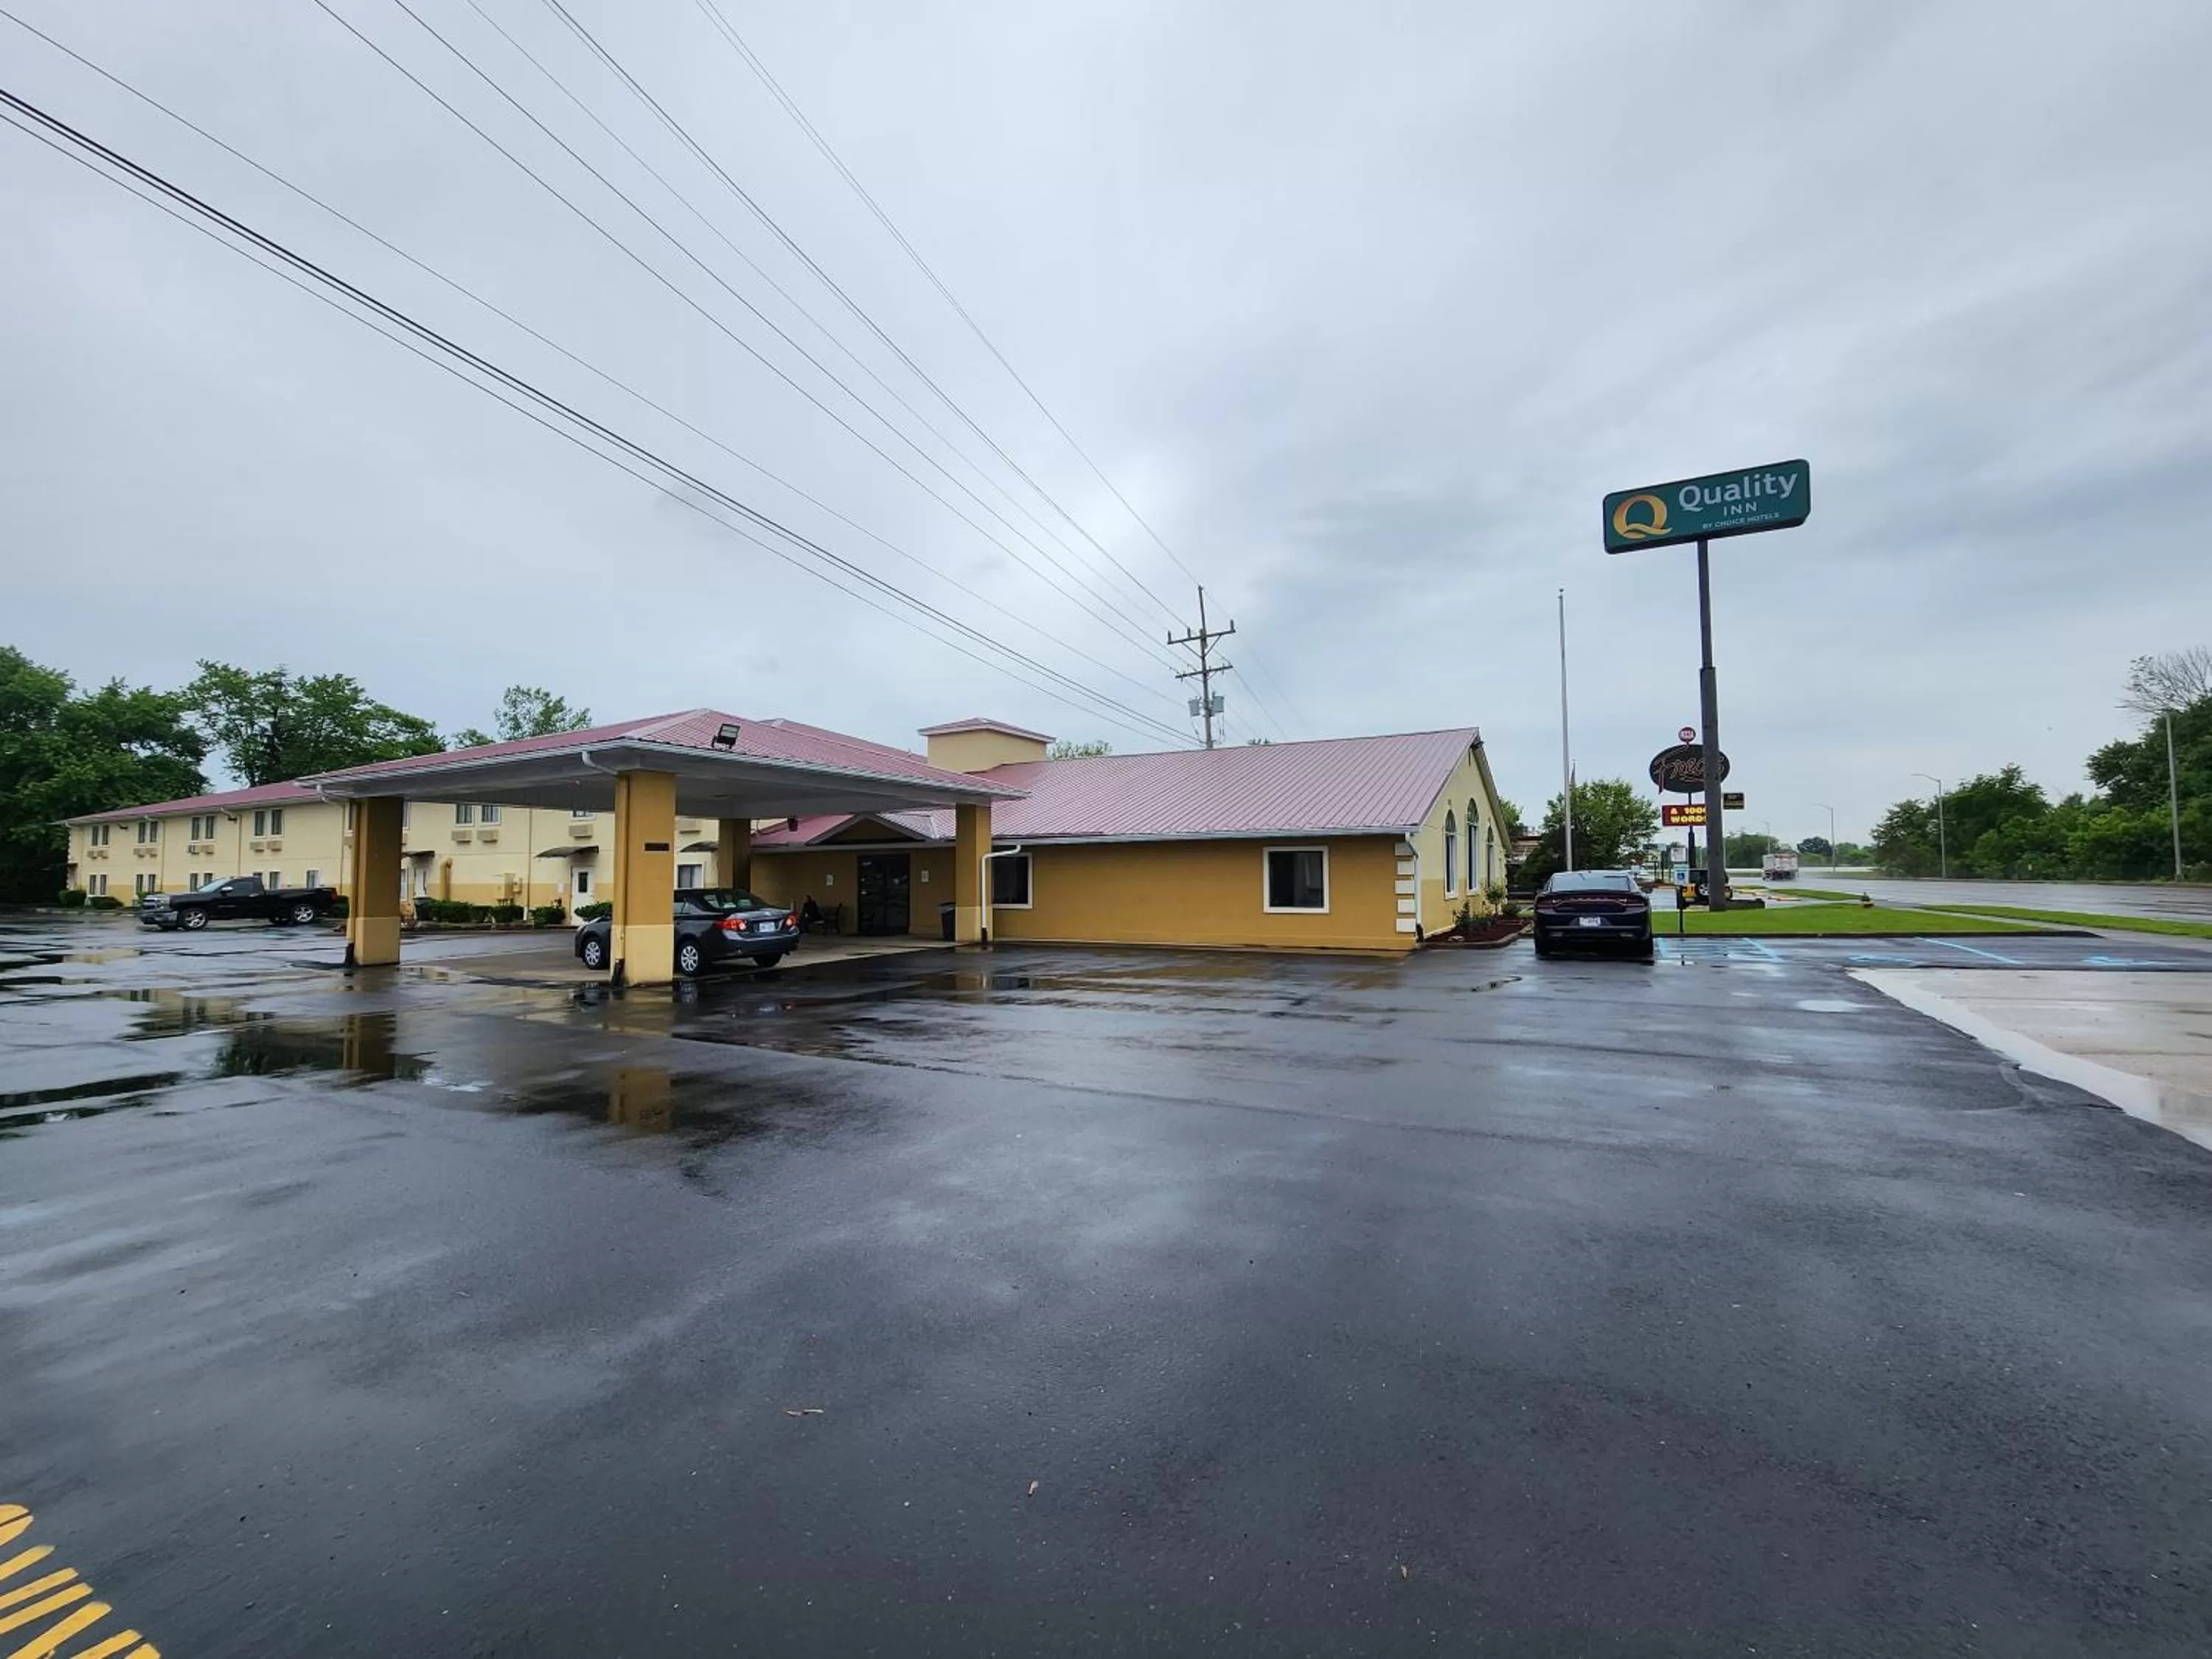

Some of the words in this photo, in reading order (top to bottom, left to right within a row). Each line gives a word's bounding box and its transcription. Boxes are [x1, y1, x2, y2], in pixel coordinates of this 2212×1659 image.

[1678, 473, 1798, 512] Quality
[1723, 501, 1758, 517] INN
[1702, 521, 1714, 530] BY
[1714, 516, 1747, 529] CHOICE
[1747, 512, 1781, 524] HOTELS
